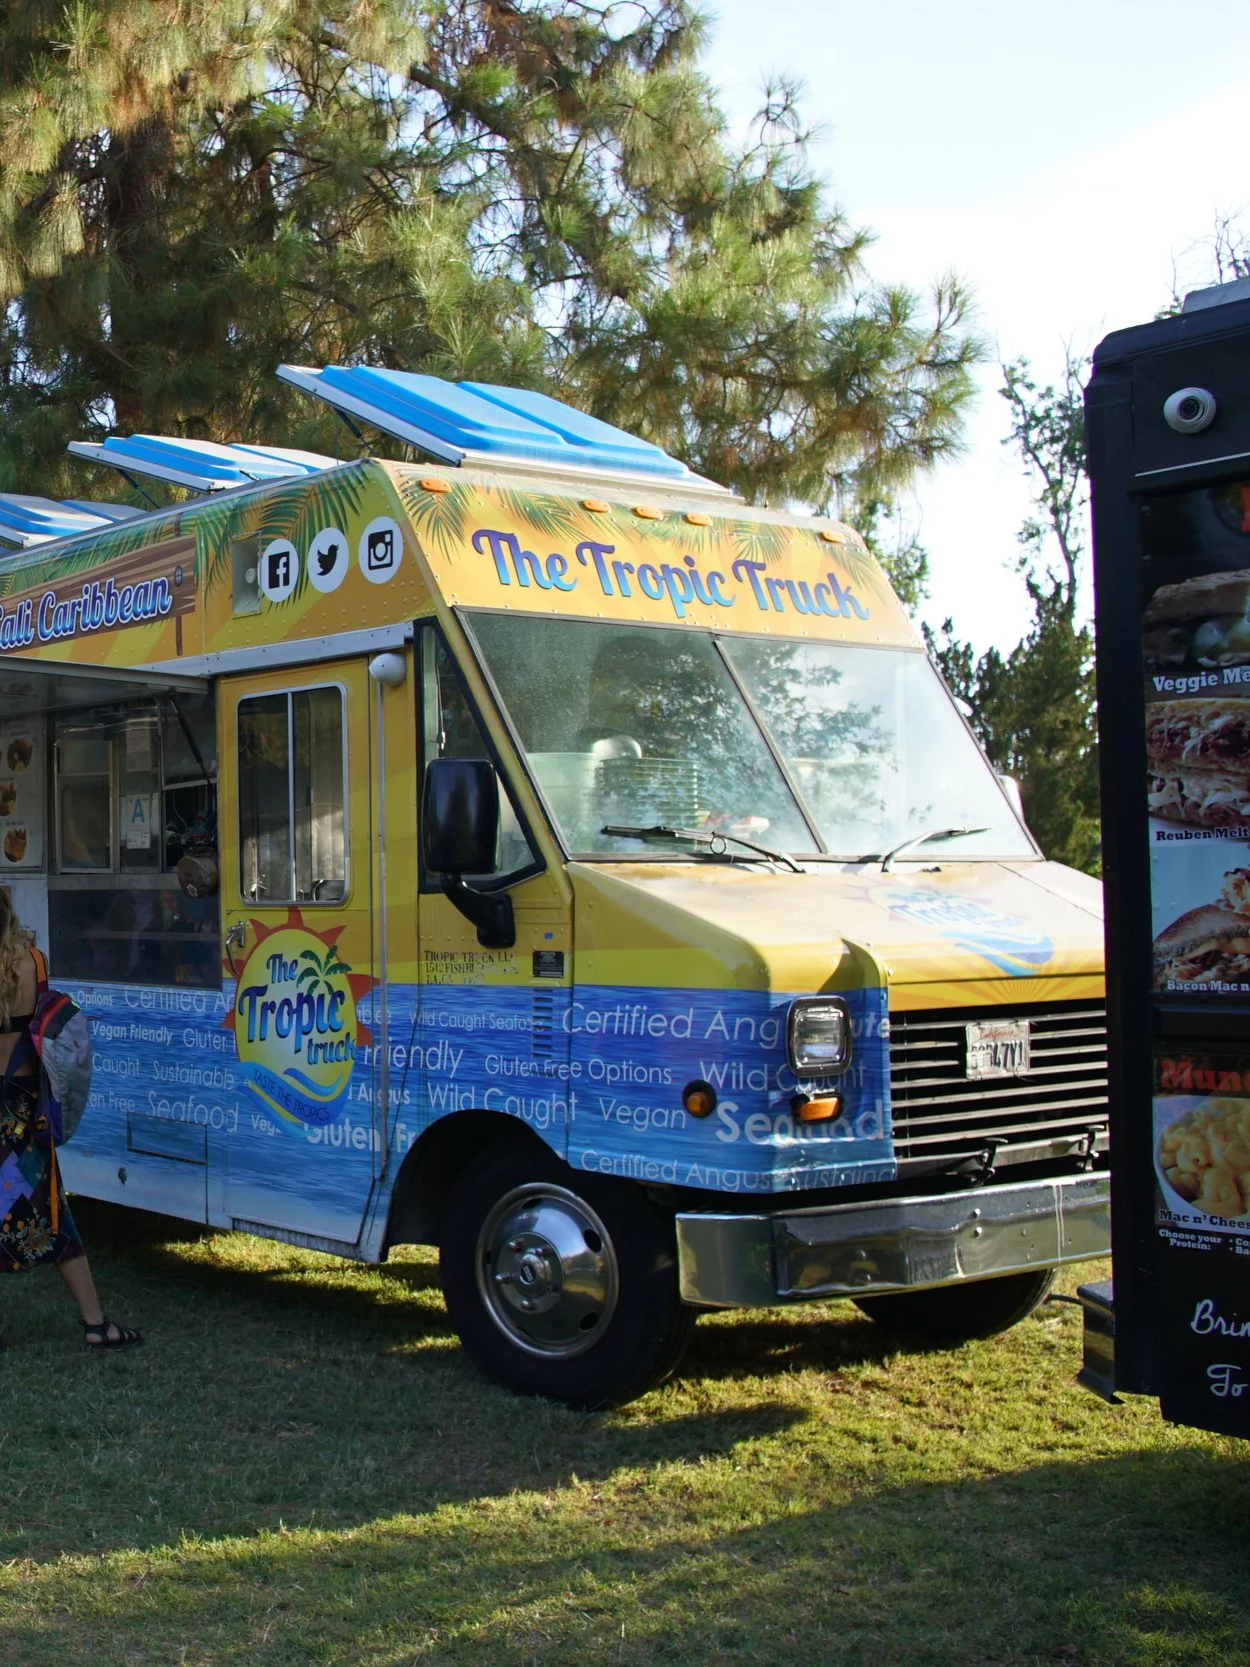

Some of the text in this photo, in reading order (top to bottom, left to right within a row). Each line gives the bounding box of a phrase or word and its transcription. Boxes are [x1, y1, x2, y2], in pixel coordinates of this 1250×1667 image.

[472, 529, 870, 621] The Tropic Truck
[38, 577, 173, 641] Caribbean
[1153, 665, 1250, 694] Veggie Me
[131, 799, 146, 824] A
[1156, 826, 1248, 841] Reuben Melt
[266, 953, 299, 984] The
[424, 951, 459, 963] TROPIC
[77, 991, 114, 1007] Options
[1167, 980, 1208, 991] Bacon
[1210, 980, 1238, 991] Mac
[92, 1020, 127, 1042] Vegan
[130, 1022, 174, 1047] Friendly
[238, 984, 346, 1055] Tropic
[409, 1010, 435, 1028] Wild
[438, 1012, 486, 1032] Caught
[562, 1003, 780, 1050] Certified Ang
[307, 1032, 357, 1066] truck
[92, 1053, 235, 1091] Caught Sustainable
[485, 1055, 672, 1086] Gluten Free Options
[699, 1060, 768, 1092] Wild
[253, 1069, 331, 1122] TASTE THE TROPICS
[427, 1082, 687, 1133] Wild Caught Vegan
[109, 1093, 136, 1113] Free
[147, 1090, 239, 1134] Seafood
[251, 1113, 282, 1137] Veg
[581, 1150, 678, 1183] Certified
[686, 1162, 770, 1194] Angus
[1160, 1210, 1190, 1223] Mac
[1159, 1229, 1250, 1247] Choose your Co
[1169, 1238, 1212, 1251] Protein:
[1190, 1299, 1250, 1337] Brin
[1207, 1364, 1249, 1397] To
